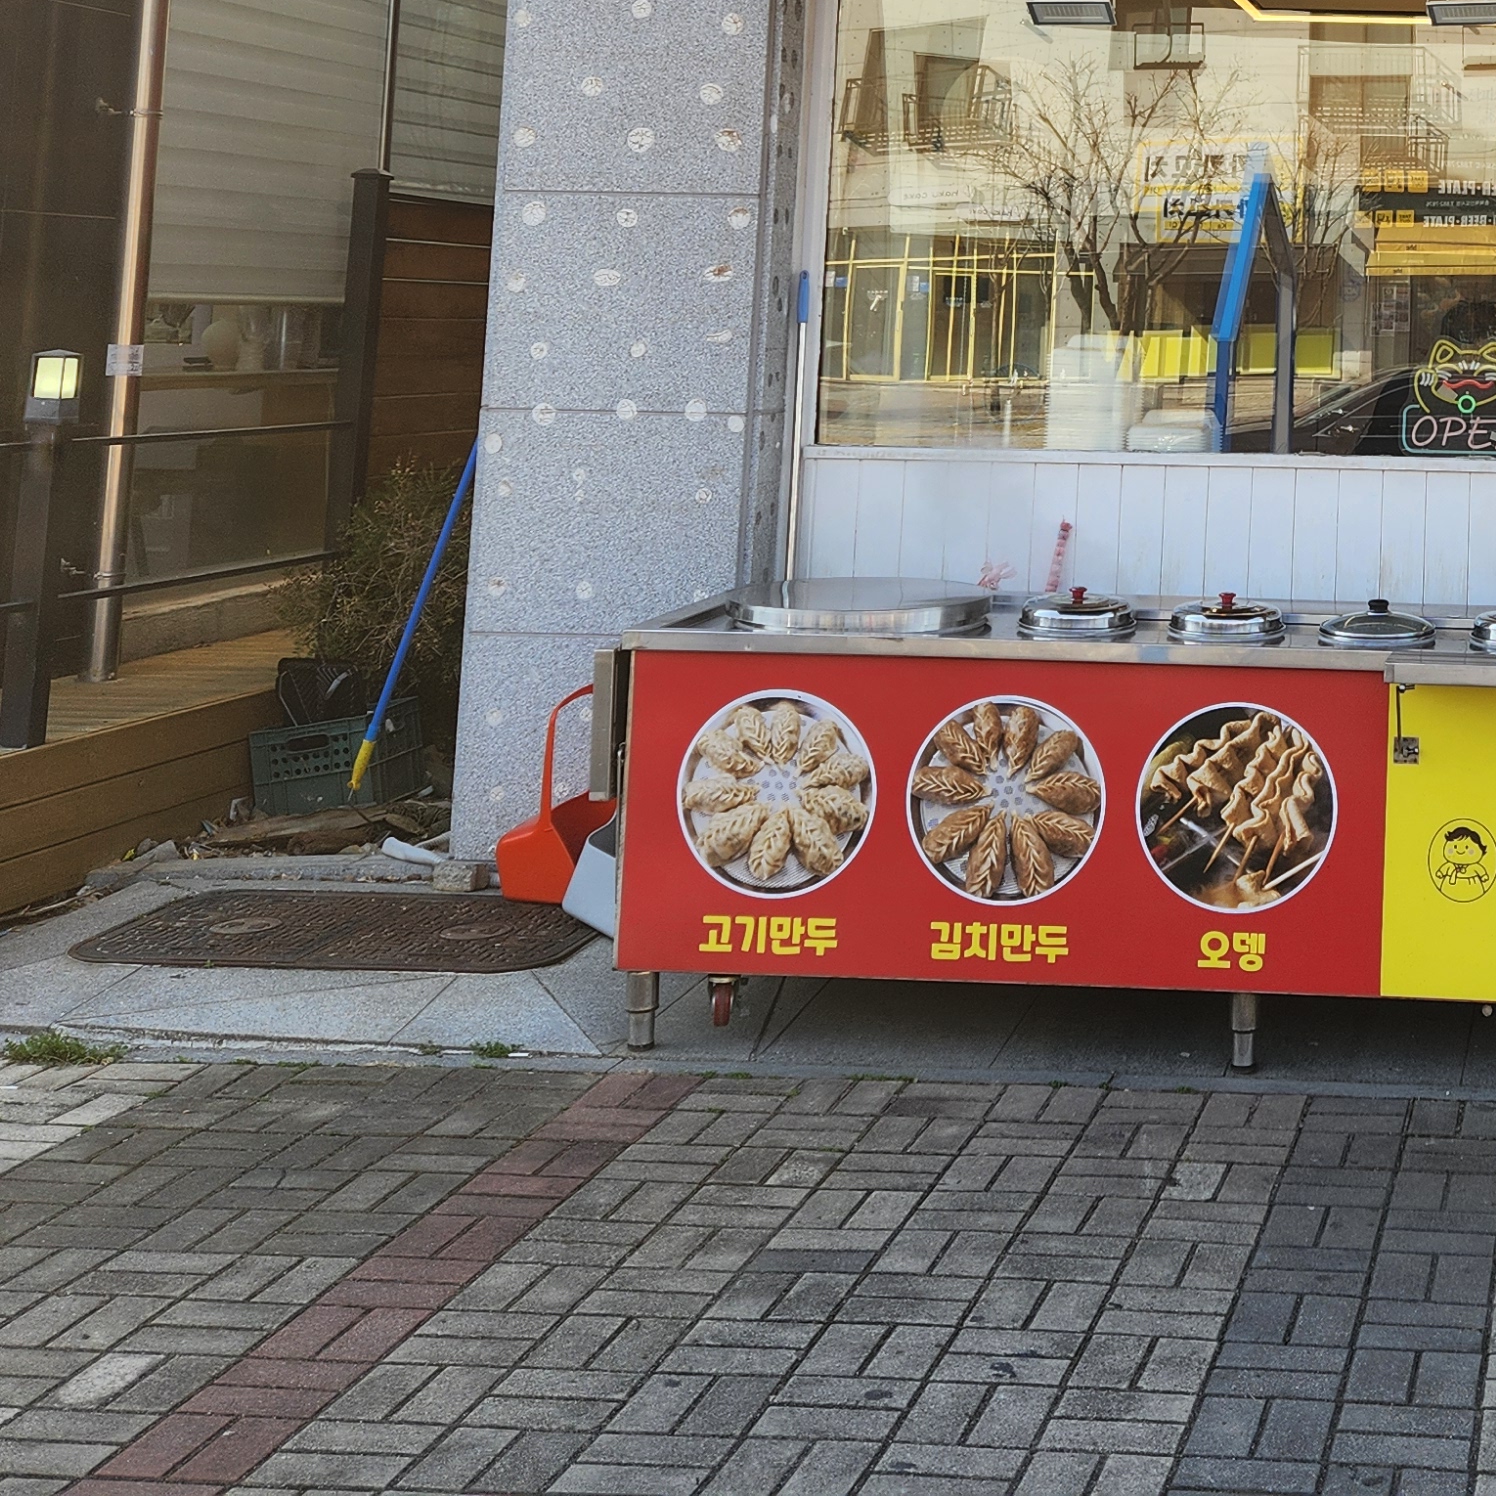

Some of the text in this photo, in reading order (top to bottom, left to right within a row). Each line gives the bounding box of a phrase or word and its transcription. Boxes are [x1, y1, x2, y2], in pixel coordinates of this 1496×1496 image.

[698, 915, 838, 957] 고기만두
[929, 921, 1069, 964] 김치만두
[1197, 929, 1267, 973] 오뎅
